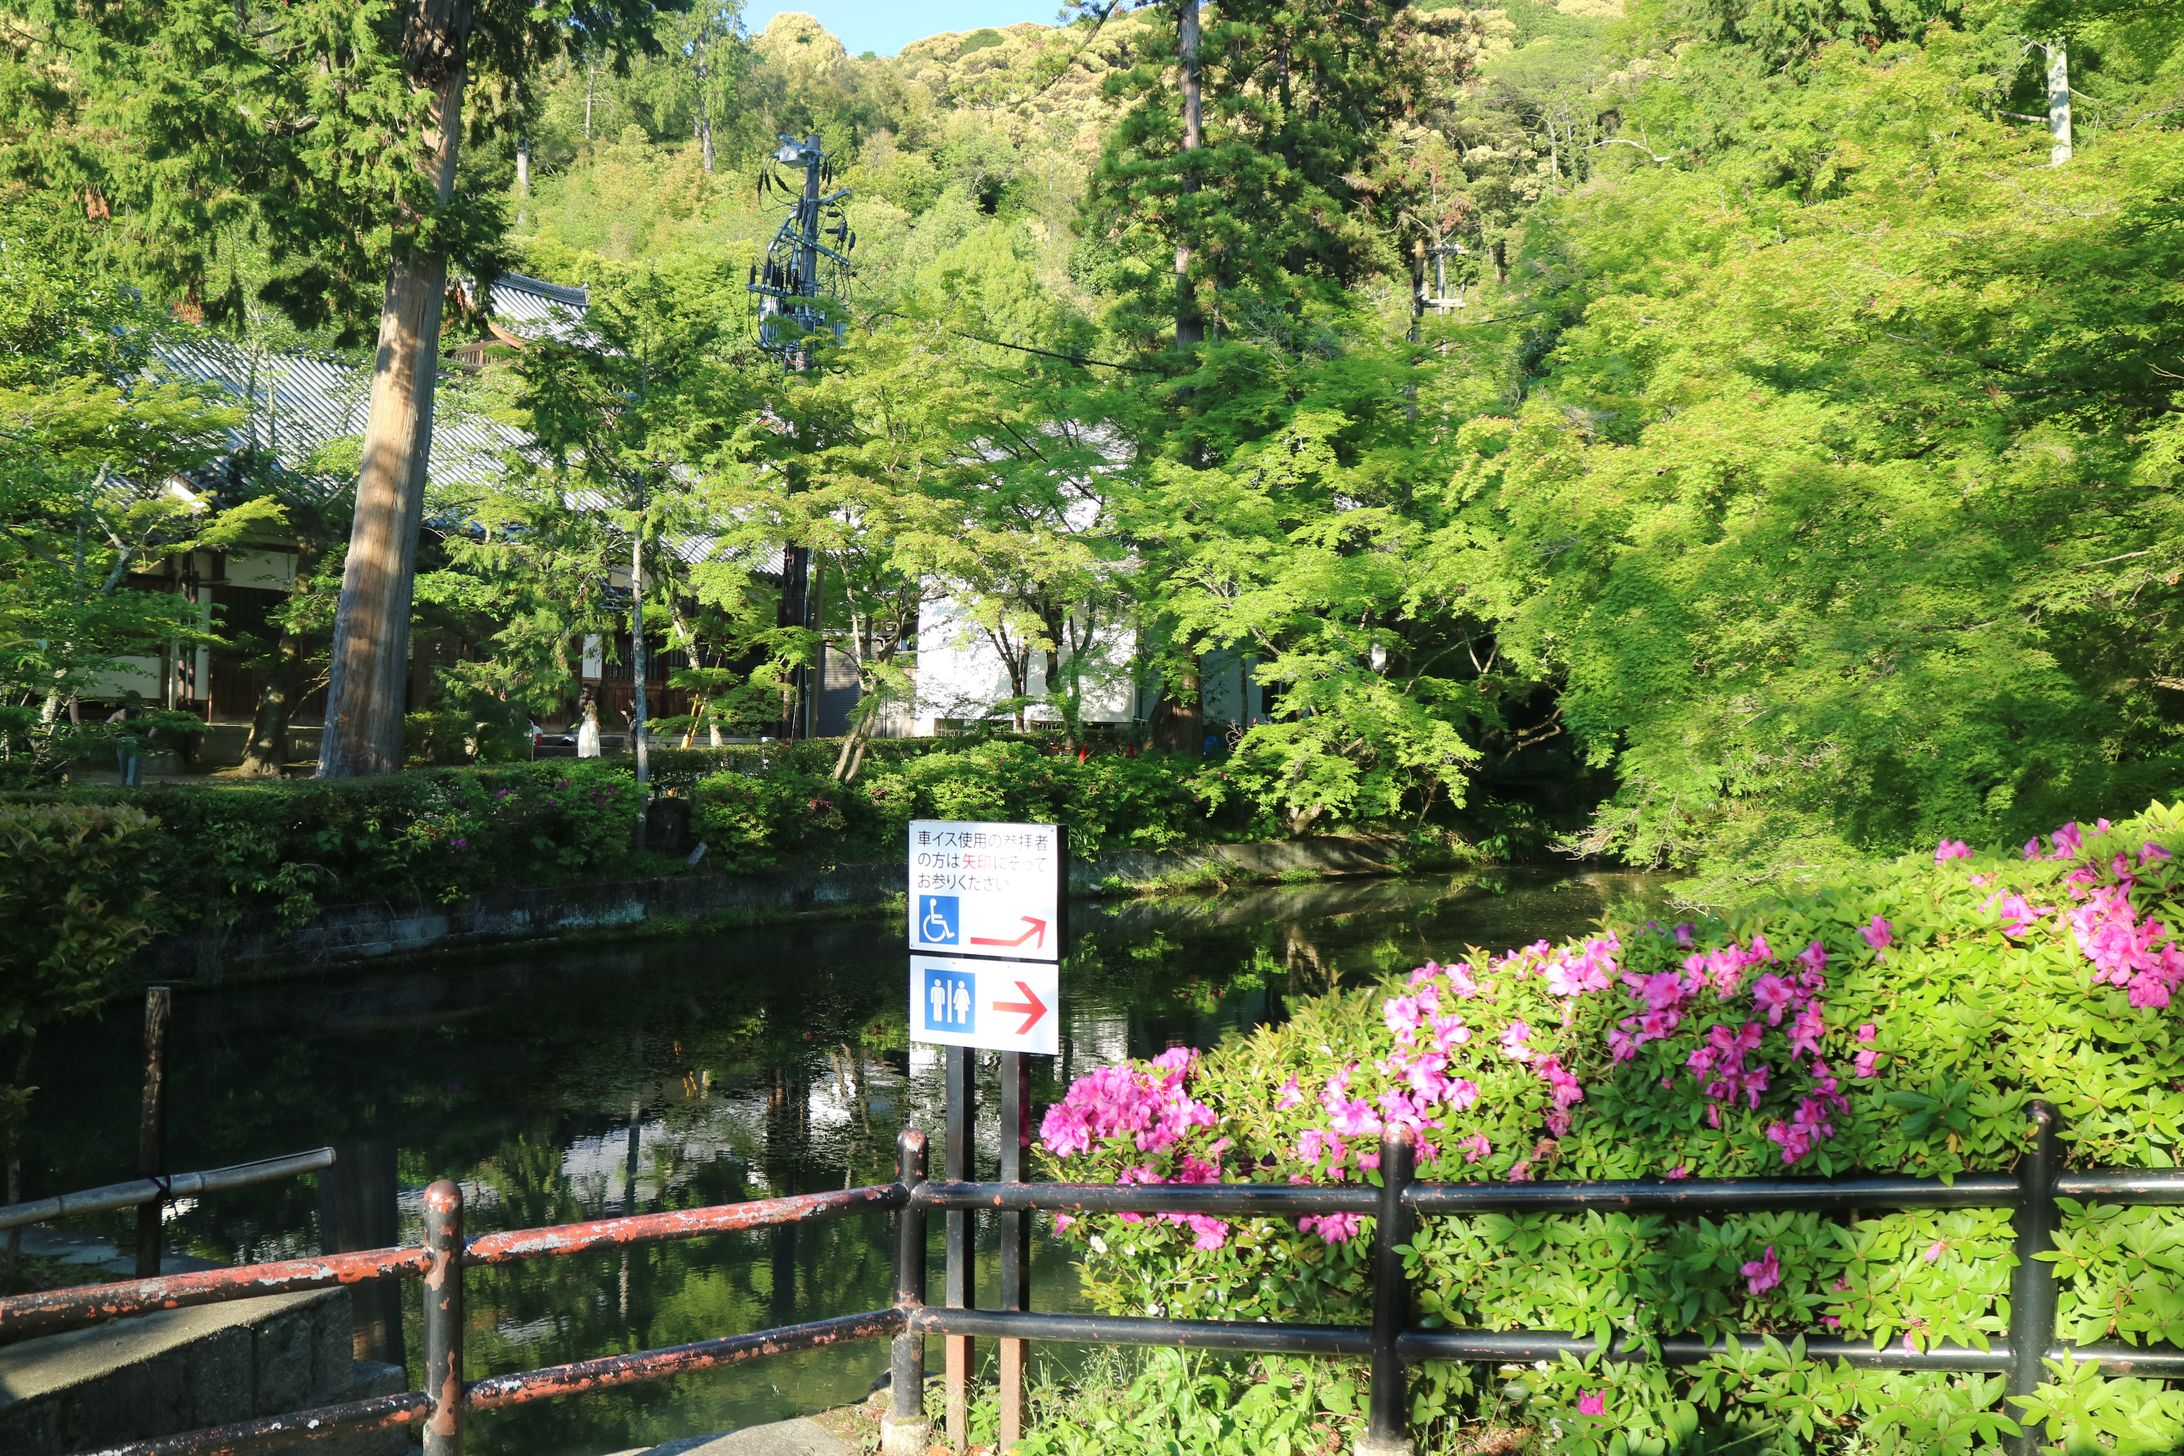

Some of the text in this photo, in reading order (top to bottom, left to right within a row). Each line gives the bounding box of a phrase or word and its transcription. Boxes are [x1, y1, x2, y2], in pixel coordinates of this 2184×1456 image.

[917, 830, 1048, 851] 車イス使用の参拝者
[917, 873, 1010, 891] お参りください
